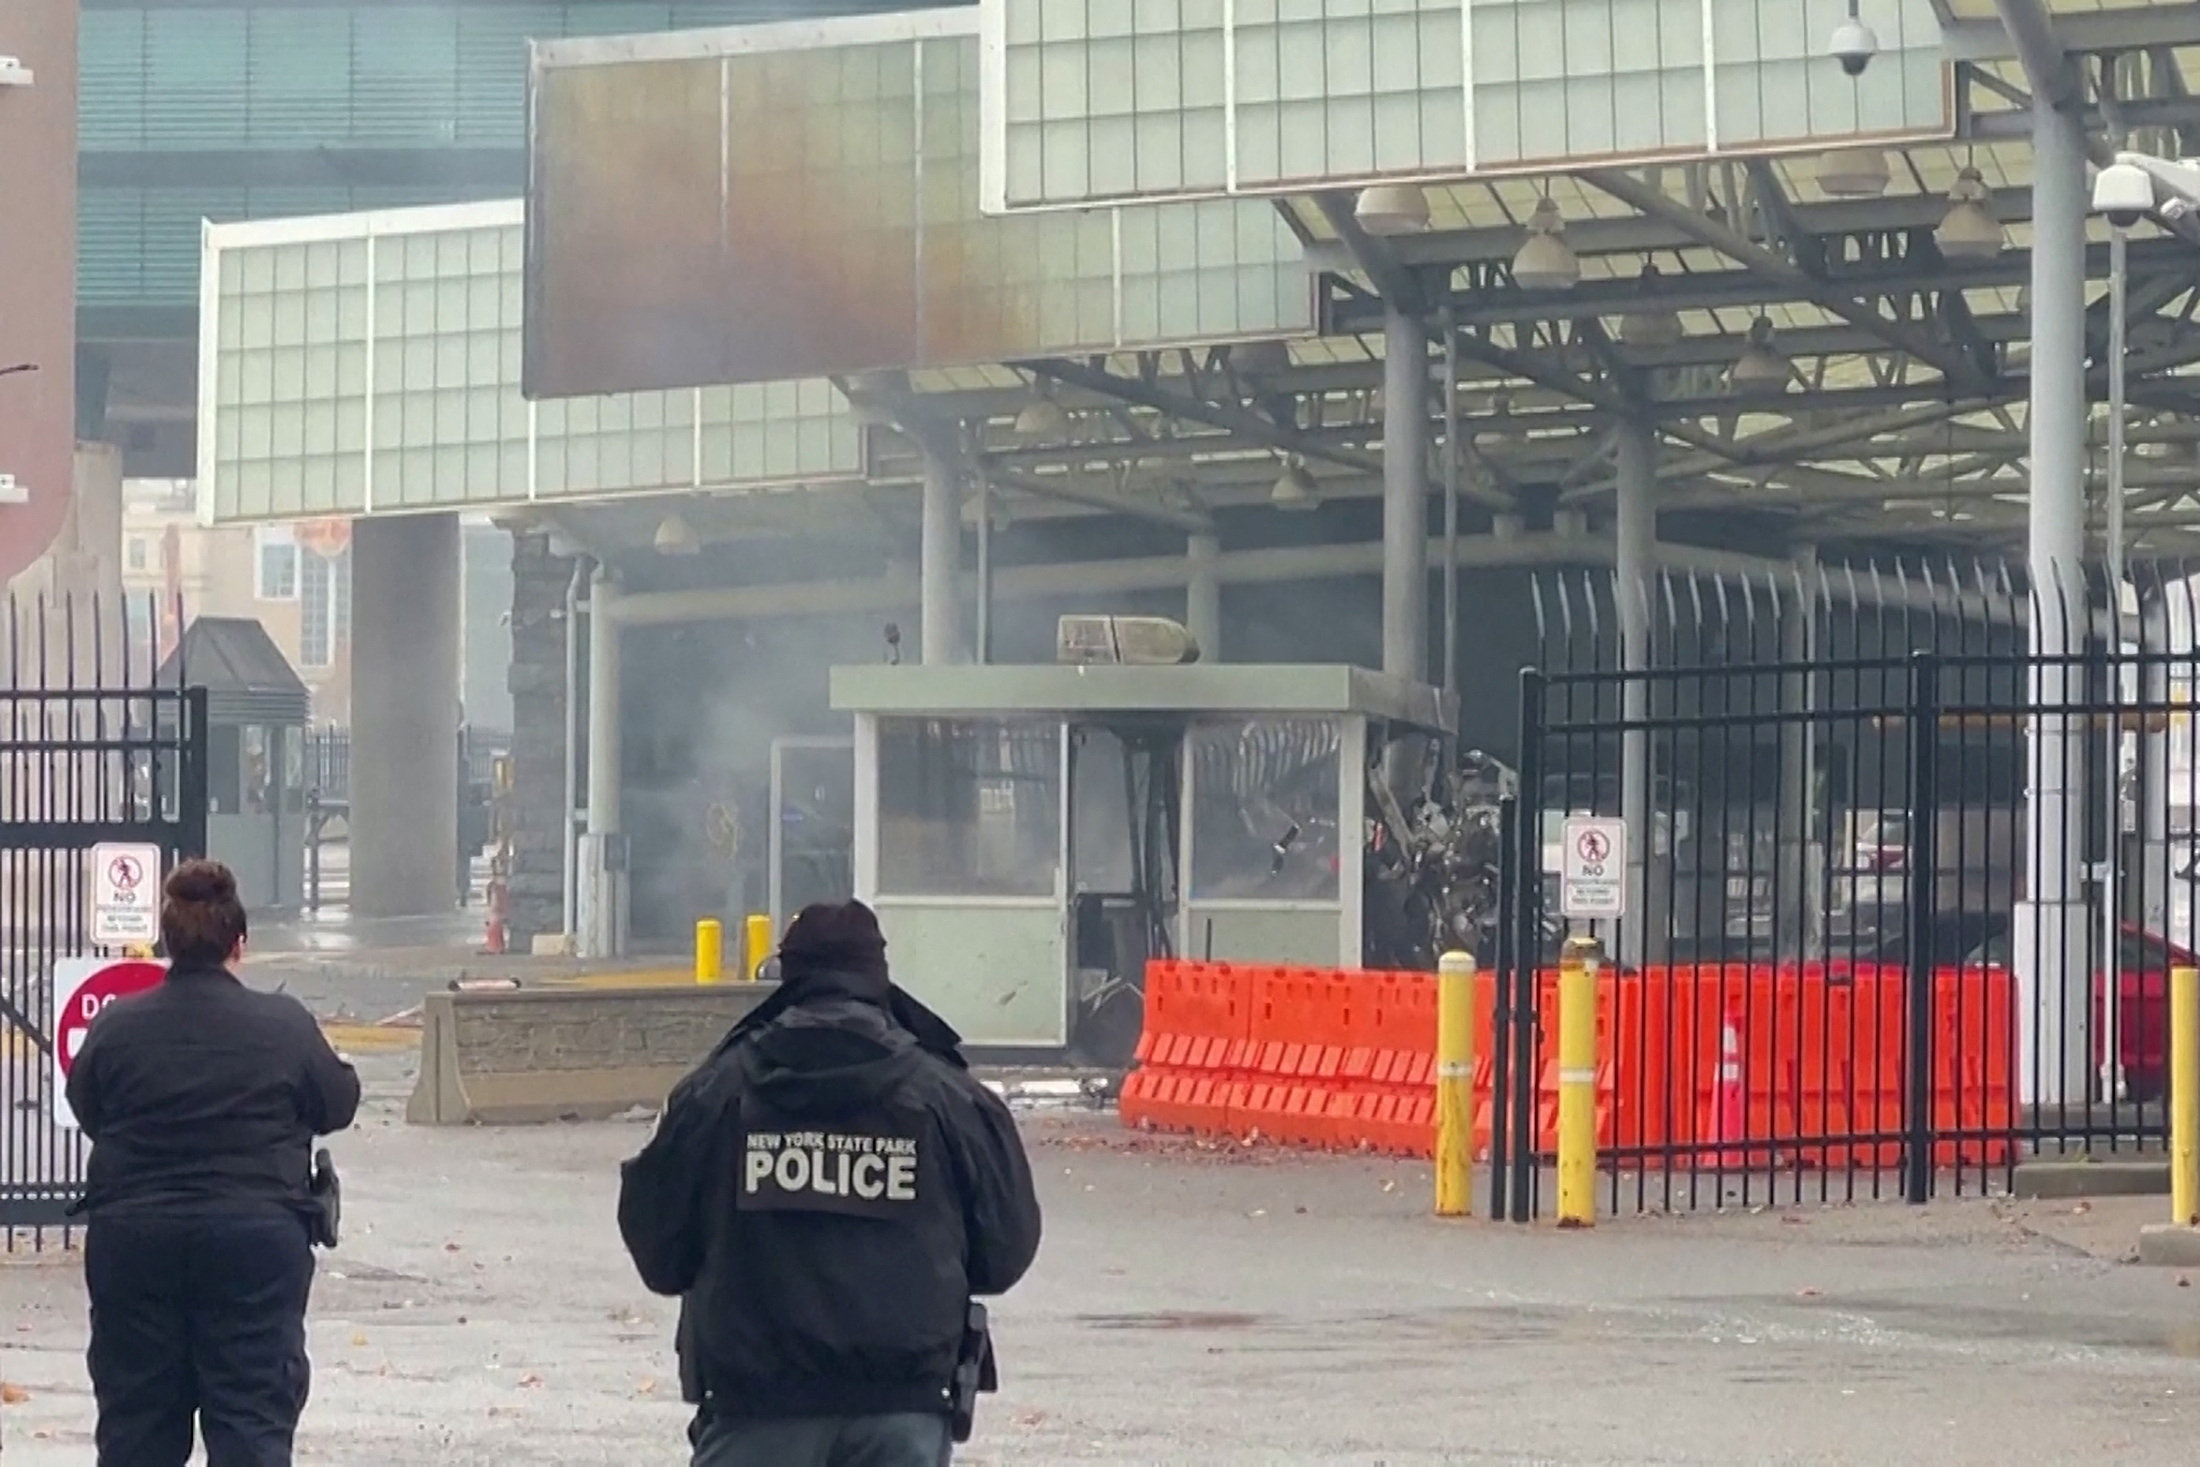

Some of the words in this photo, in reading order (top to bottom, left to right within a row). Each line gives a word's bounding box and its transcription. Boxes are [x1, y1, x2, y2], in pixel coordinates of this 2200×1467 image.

[1582, 865, 1604, 877] NO
[113, 890, 136, 903] NO
[746, 1133, 781, 1149] NEW
[784, 1131, 825, 1149] YORK
[827, 1134, 873, 1152] STATE
[875, 1137, 917, 1154] PARK
[745, 1147, 917, 1200] POLICE
